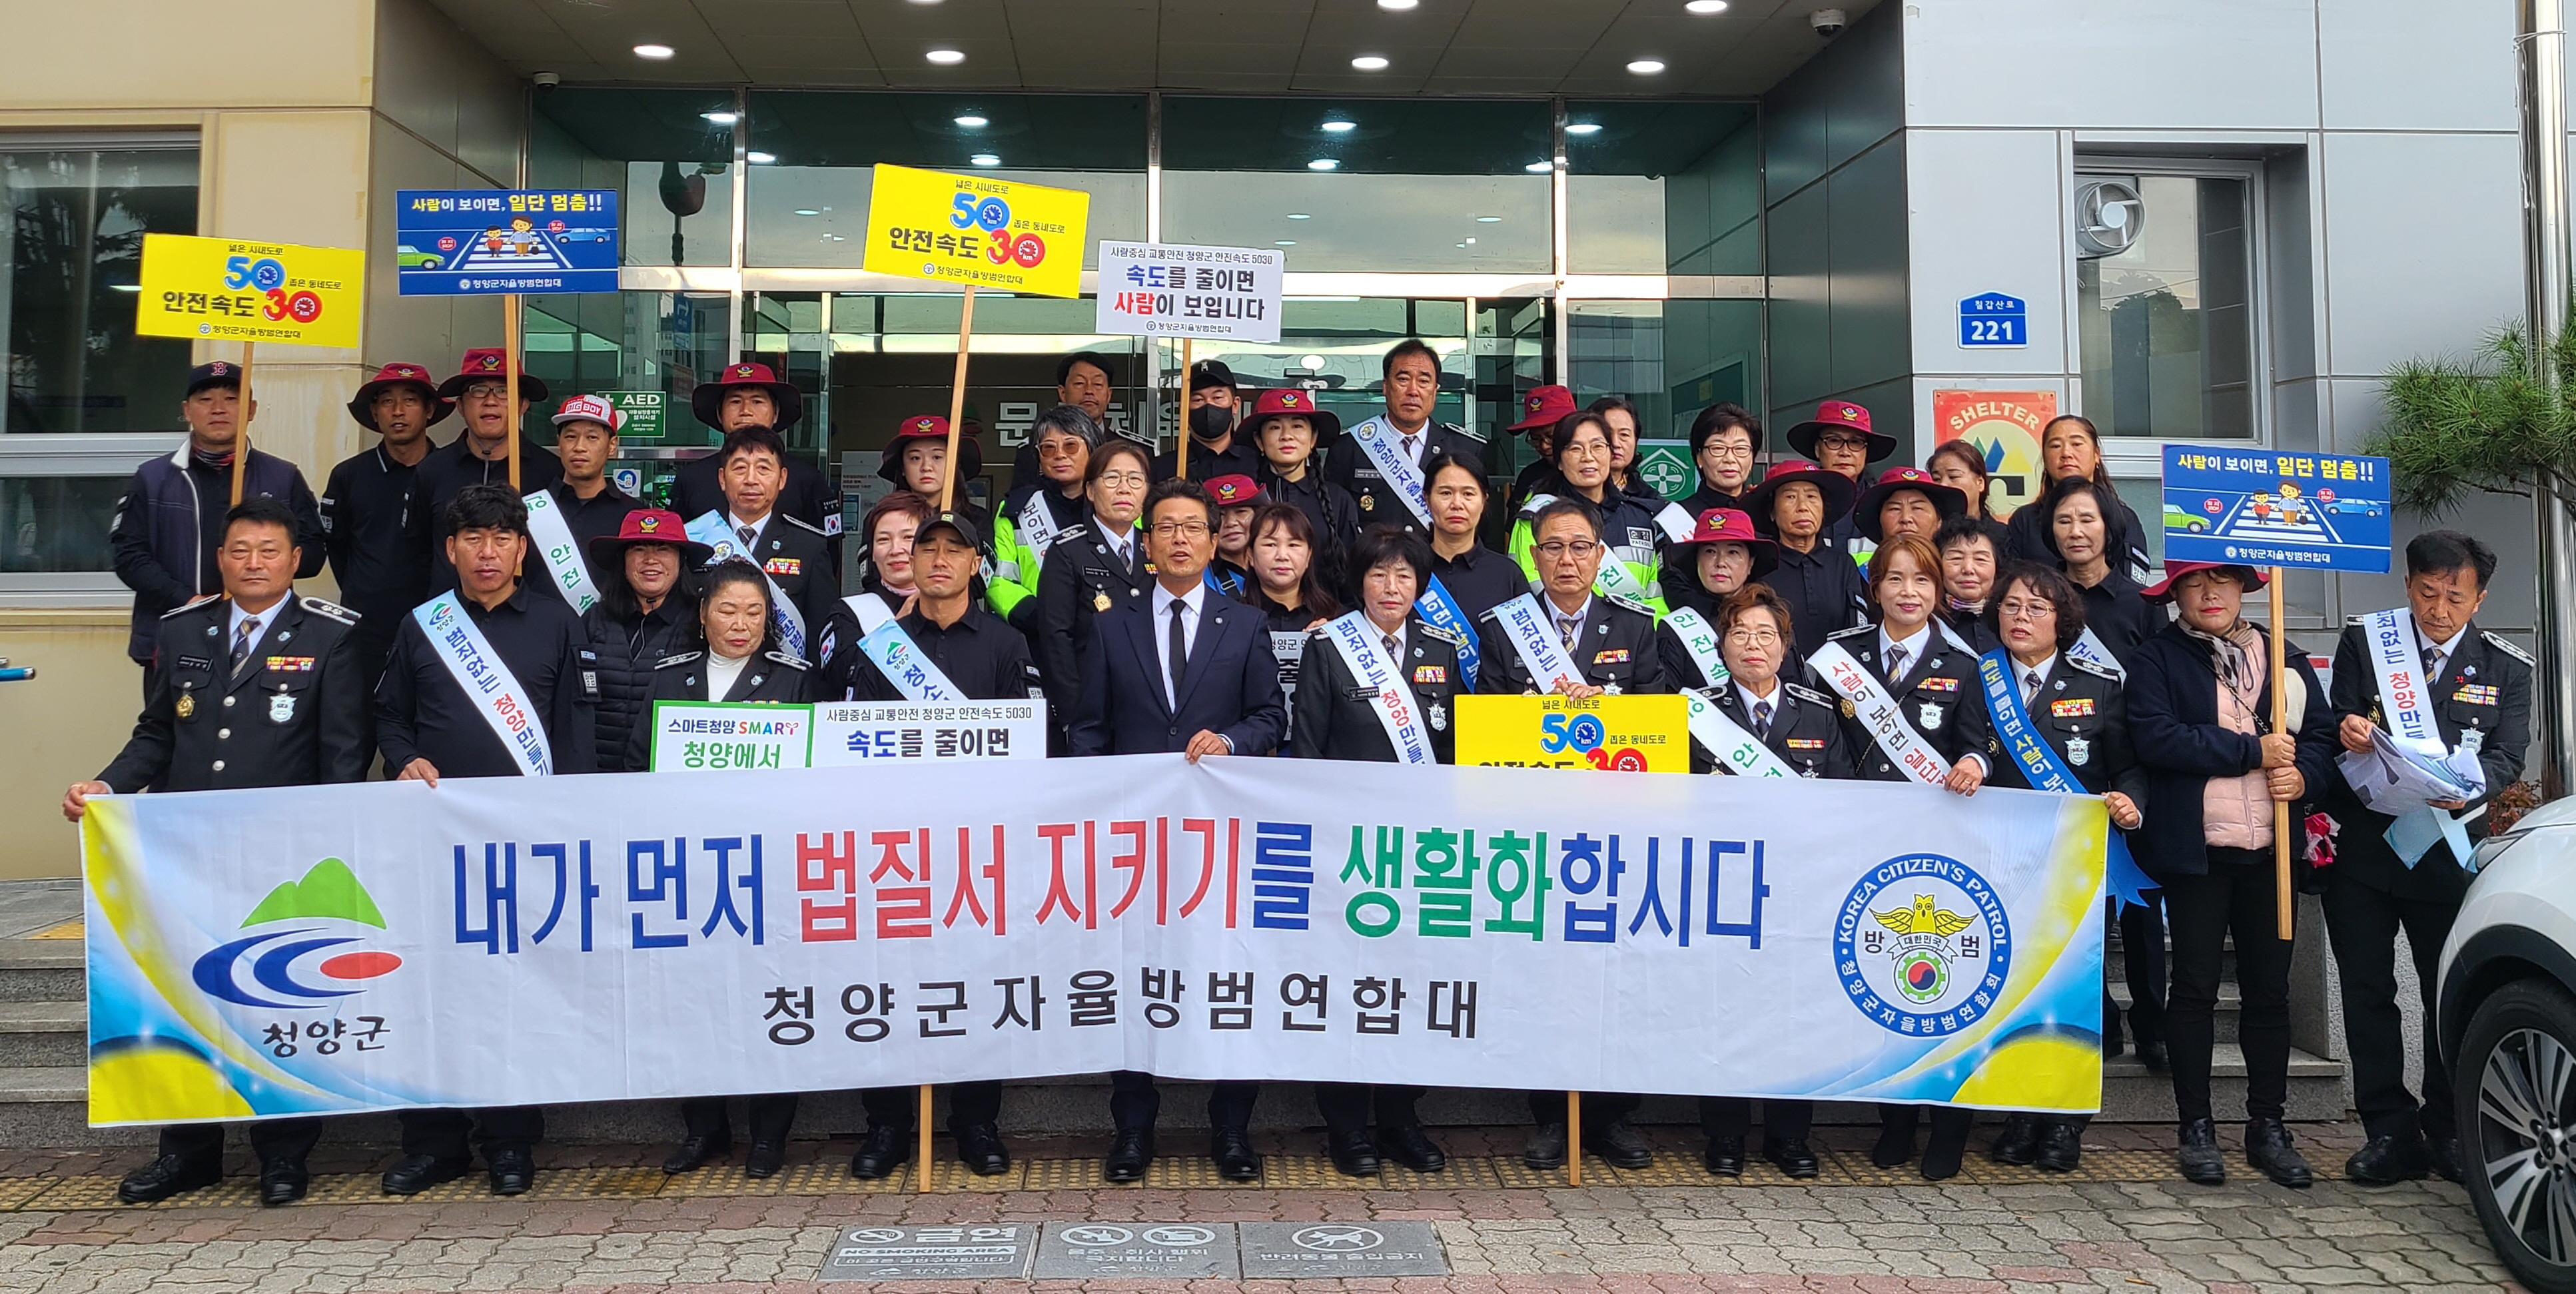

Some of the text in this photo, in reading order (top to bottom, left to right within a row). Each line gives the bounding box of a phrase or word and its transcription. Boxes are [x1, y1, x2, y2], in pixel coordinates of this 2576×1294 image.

[975, 181, 1009, 195] 시내도로
[412, 193, 602, 213] 사람이 보이면, 일단 멈춤!!
[950, 192, 1010, 232] 50
[1033, 221, 1065, 234] 동네도로
[889, 227, 979, 259] 안전속도
[987, 228, 1045, 268] 30
[1110, 247, 1272, 265] 사람중심 교통안전 청양군 안전속도 5030
[224, 255, 286, 291] 50
[1126, 265, 1254, 293] 속도를 줄이면
[163, 291, 255, 317] 안전속도
[262, 288, 322, 323] 30
[1114, 292, 1264, 321] 사람이 보입니다
[1975, 300, 2014, 310] 칠갑산로
[1970, 321, 2013, 340] 221
[622, 394, 660, 405] AED
[1950, 402, 2040, 430] SHELTER
[2178, 454, 2373, 481] 사람이 보이면, 일단 멈춤!!
[1511, 606, 1559, 673] 범죄없는
[445, 626, 501, 694] 범죄없는
[903, 664, 951, 700] 청소
[1335, 619, 1389, 685] 범죄없는
[1380, 688, 1426, 764] 청양만들
[827, 708, 1032, 722] 사람중심 교통안전 청양군 안전속도 5030
[1542, 700, 1600, 710] 넓은 시내도로
[1832, 662, 1875, 702] 사람이
[1869, 704, 1909, 751] 보이면
[668, 718, 735, 734] 스마트청양
[1541, 714, 1604, 754] 50
[683, 741, 781, 769] 청양에서
[847, 728, 1009, 758] 속도를 줄이면
[2016, 734, 2050, 774] 사람이
[453, 816, 1770, 955] 내가 먼저 법질서 지키기를 생활화합시다
[1839, 858, 2007, 950] KOREA CITIZEN'S PATROL
[1904, 936, 1942, 947] 대한민국
[763, 966, 1478, 1047] 청양군자율방범연합대
[262, 1015, 391, 1058] 청양군
[915, 1227, 1017, 1242] 금연
